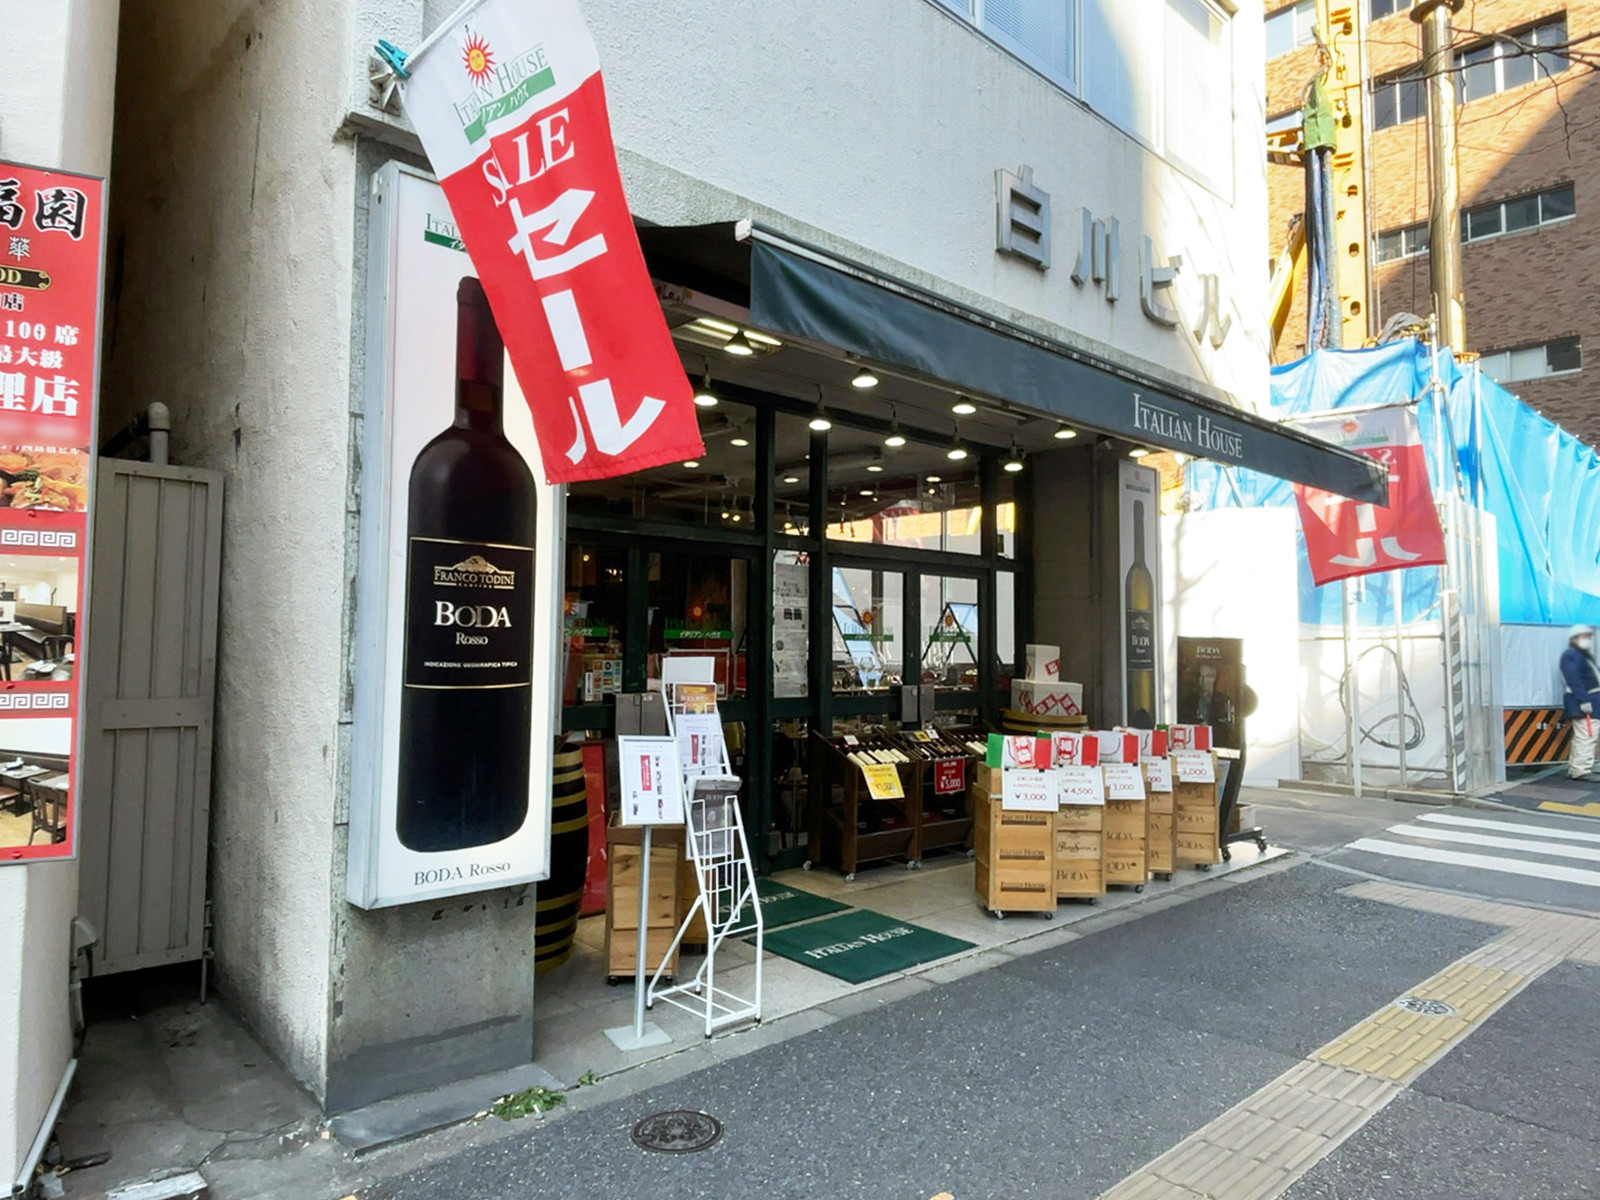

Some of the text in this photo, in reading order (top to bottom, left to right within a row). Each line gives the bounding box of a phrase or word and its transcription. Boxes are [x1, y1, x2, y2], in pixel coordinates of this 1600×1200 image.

[481, 107, 574, 207] SLE
[426, 212, 460, 238] ITAL
[8, 236, 31, 261] 華
[994, 163, 1232, 351] 白川ビル
[507, 188, 666, 465] セール
[1133, 393, 1243, 459] ITALIAN HOUSE
[434, 569, 478, 583] FRANCO
[479, 573, 515, 586] TODINI
[434, 600, 512, 628] BODA
[414, 866, 463, 886] BODA
